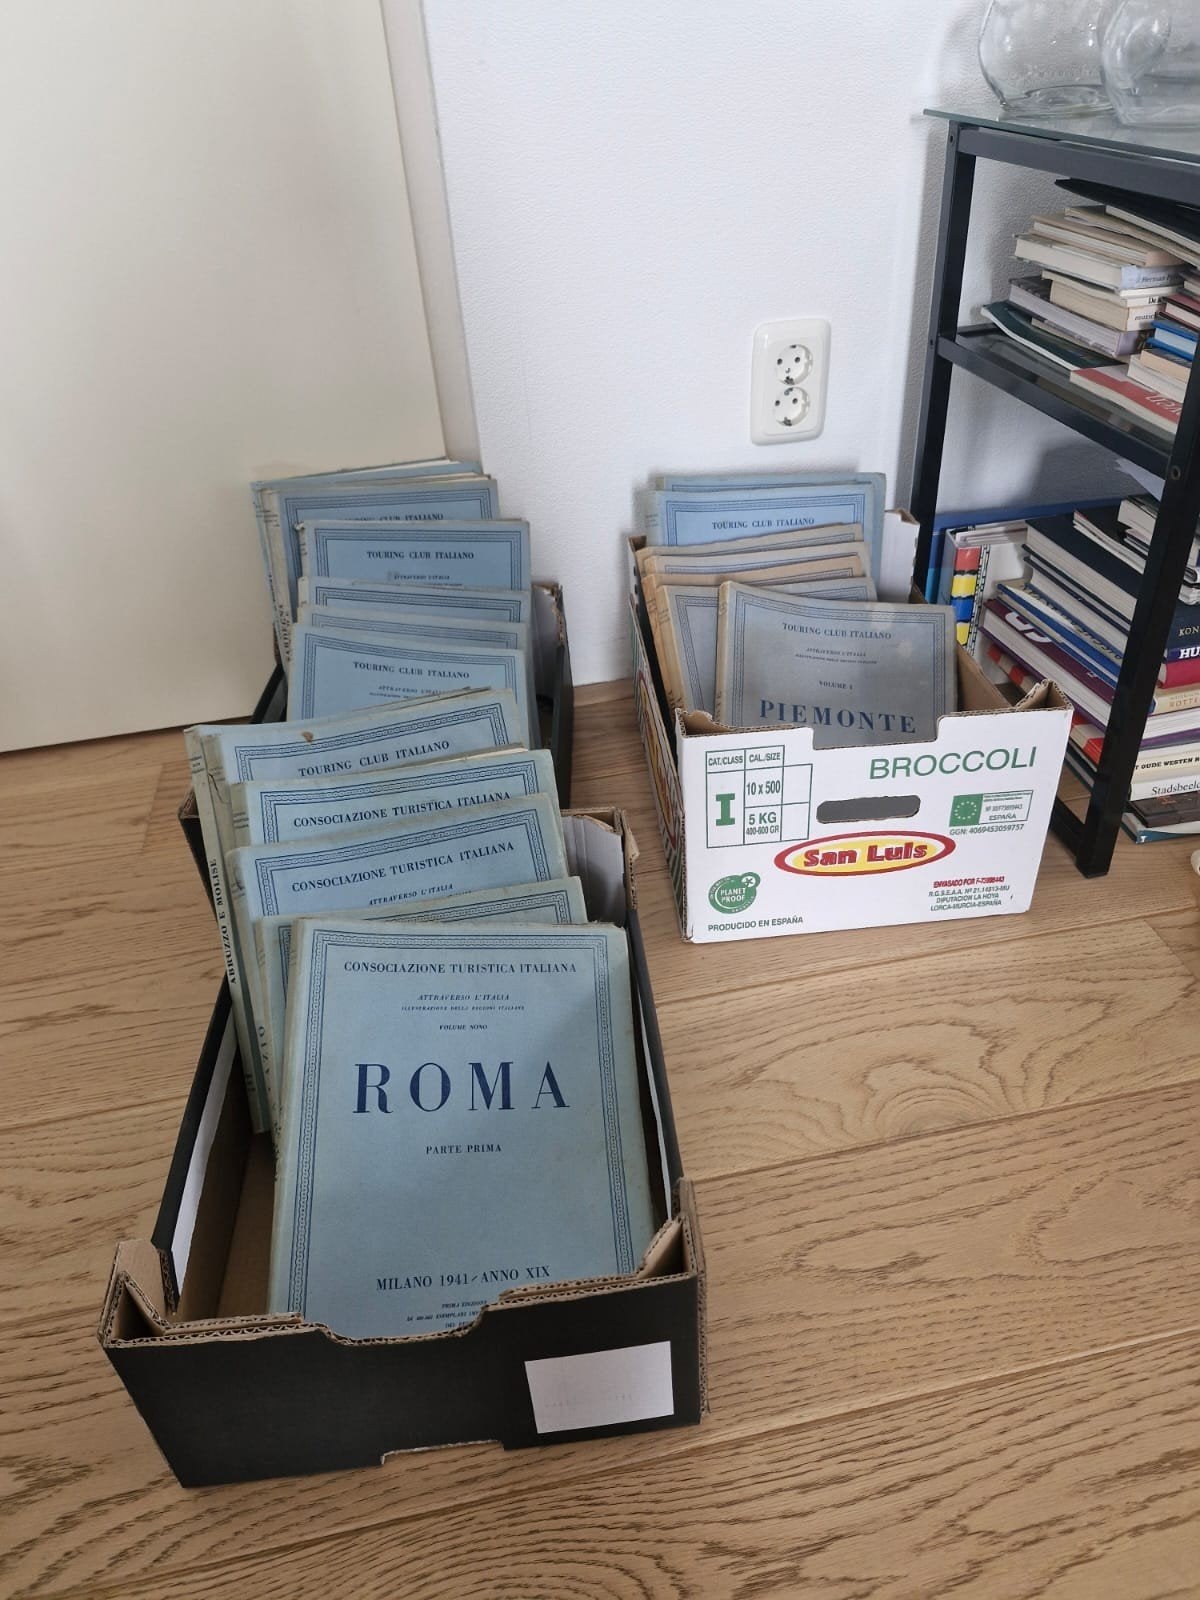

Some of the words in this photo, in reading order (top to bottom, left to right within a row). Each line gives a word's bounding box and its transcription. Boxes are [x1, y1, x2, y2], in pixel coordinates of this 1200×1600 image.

[711, 521, 748, 530] TOURING
[752, 520, 773, 528] CLUB
[776, 518, 815, 527] ITALIANO
[366, 551, 405, 559] TOURING
[409, 551, 431, 560] CLUB
[435, 551, 474, 560] ITALIANO
[781, 622, 821, 635] TOURING
[823, 629, 847, 637] CLUB
[849, 630, 892, 640] ITALIANO
[353, 661, 395, 673] TOURING
[398, 667, 423, 677] CLUB
[427, 669, 470, 679] ITALIANO
[818, 680, 847, 690] VOLUME
[759, 698, 917, 734] PIEMONTE
[297, 759, 353, 778] TOURING
[358, 752, 390, 767] CLUB
[395, 739, 451, 760] ITALIANO
[869, 745, 1038, 780] BROCCOLI
[1140, 761, 1162, 770] OUDE
[1163, 757, 1194, 766] WESTEN
[746, 782, 757, 795] 10
[765, 779, 781, 795] 500
[293, 808, 388, 829] CONSOCIAZIONE
[391, 799, 452, 818] TURISTICA
[457, 790, 512, 808] ITALIANA
[715, 793, 736, 827] I
[988, 812, 1017, 821] ESPAÑA
[748, 813, 756, 825] 5
[759, 811, 777, 824] KG
[769, 824, 780, 833] GR
[949, 828, 968, 836] GGN:
[803, 848, 858, 868] San
[866, 841, 929, 864] Luis
[291, 867, 388, 894] CONSOCIAZIONE
[389, 852, 454, 877] TURISTICA
[459, 841, 515, 862] ITALIANA
[208, 858, 224, 906] MOLISE
[933, 878, 963, 889] ENVASADO
[963, 877, 976, 887] POR
[369, 889, 418, 906] ATTRAVERSO
[420, 882, 454, 897] L'ITALIA
[720, 887, 747, 897] PLANET
[721, 894, 746, 904] PROOF
[936, 895, 974, 904] DIPUTACION
[982, 892, 1000, 900] HOYA
[217, 911, 226, 920] E
[707, 920, 757, 932] PRODUCIDO
[758, 919, 770, 928] EN
[771, 914, 804, 926] ESPAÑA
[220, 925, 238, 985] ABRUZZO
[343, 960, 446, 975] CONSOCIAZIONE
[450, 962, 516, 975] TURISTICA
[519, 961, 577, 974] ITALIANA
[474, 993, 510, 1001] L'ITALIA
[351, 1060, 572, 1115] ROMA
[425, 1144, 463, 1156] PARTE
[466, 1143, 503, 1154] PRIMA
[375, 1275, 433, 1292] MILANO
[525, 1264, 552, 1280] XIX
